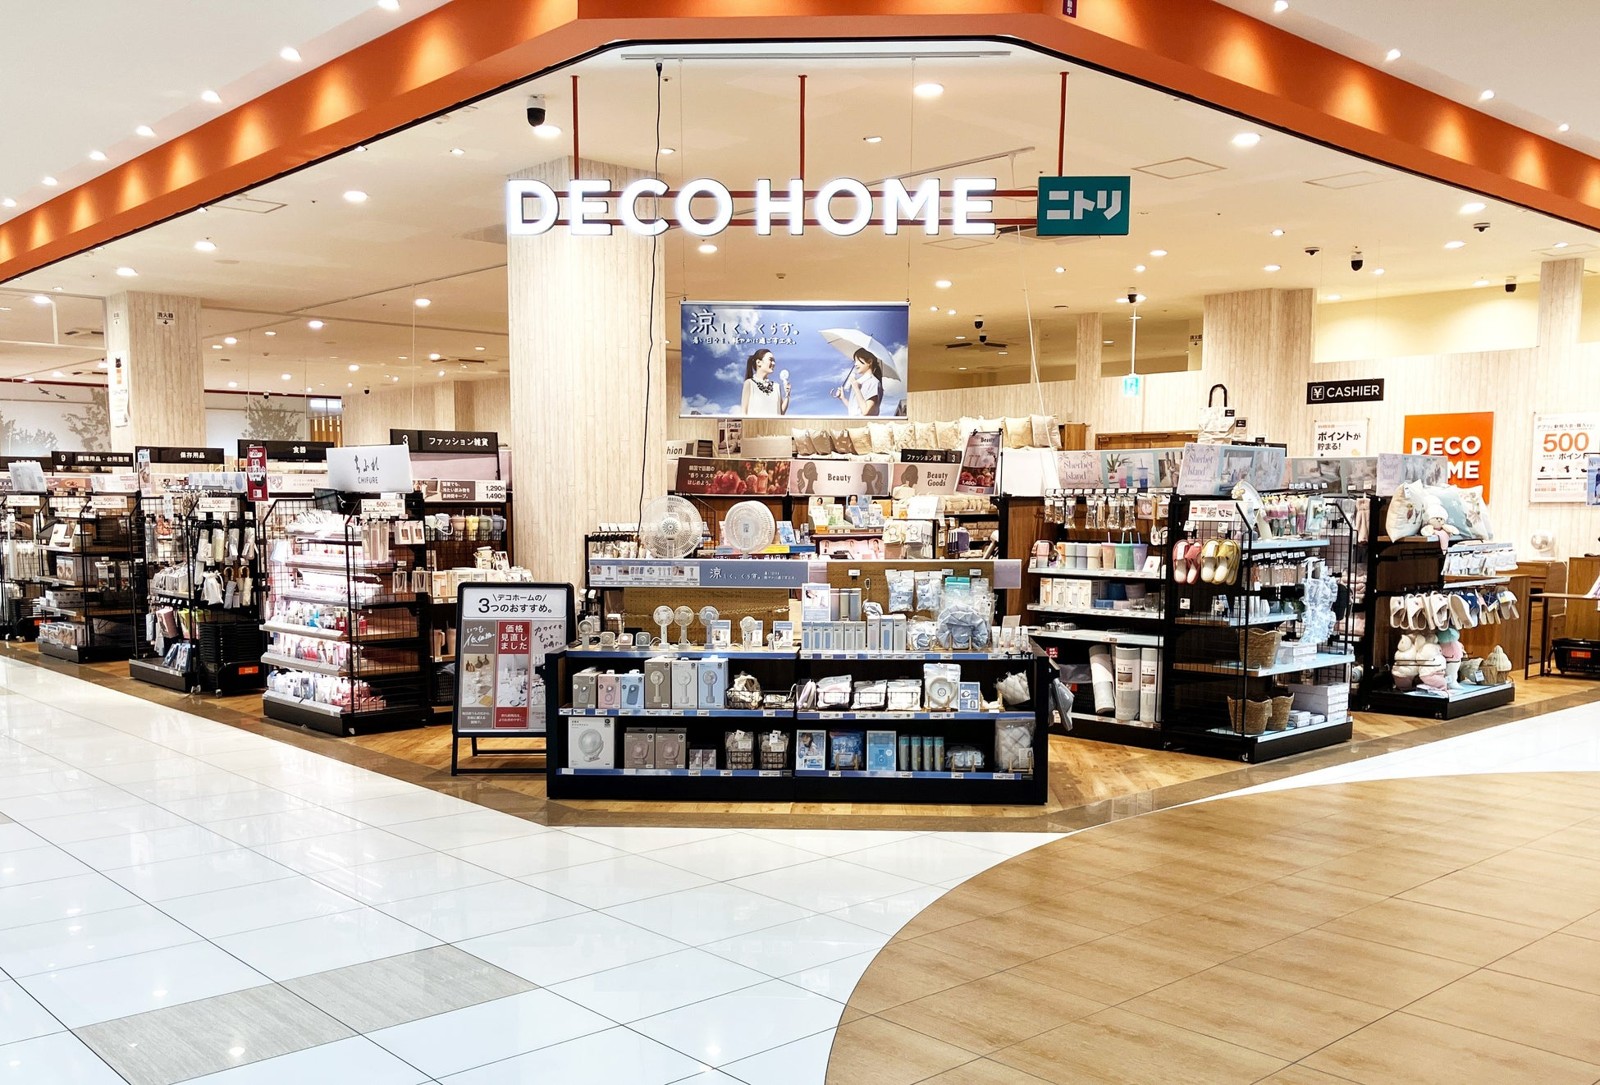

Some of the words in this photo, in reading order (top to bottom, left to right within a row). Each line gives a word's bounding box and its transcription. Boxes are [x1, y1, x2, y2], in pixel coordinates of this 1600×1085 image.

[508, 178, 734, 236] DECO
[757, 178, 997, 236] HOME
[1046, 190, 1122, 220] ニトリ
[689, 308, 800, 335] 涼しく、くらす。
[1326, 385, 1380, 398] CASHIER
[402, 435, 409, 445] 3
[1318, 431, 1361, 442] ポイントが
[429, 437, 489, 447] ファッション雑貨
[1411, 436, 1482, 456] DECO
[1543, 432, 1589, 452] 500
[292, 446, 306, 454] 食器
[666, 446, 683, 455] hion
[61, 454, 66, 462] 9
[951, 454, 956, 463] 3
[354, 454, 380, 474] ちふれ
[1447, 460, 1480, 479] ME
[357, 476, 379, 484] CHIFURE
[827, 473, 851, 483] Beauty
[926, 471, 948, 481] Beauty
[927, 479, 946, 487] Goods
[505, 625, 524, 633] 価格
[500, 633, 527, 642] 見直し
[500, 642, 528, 650] ました
